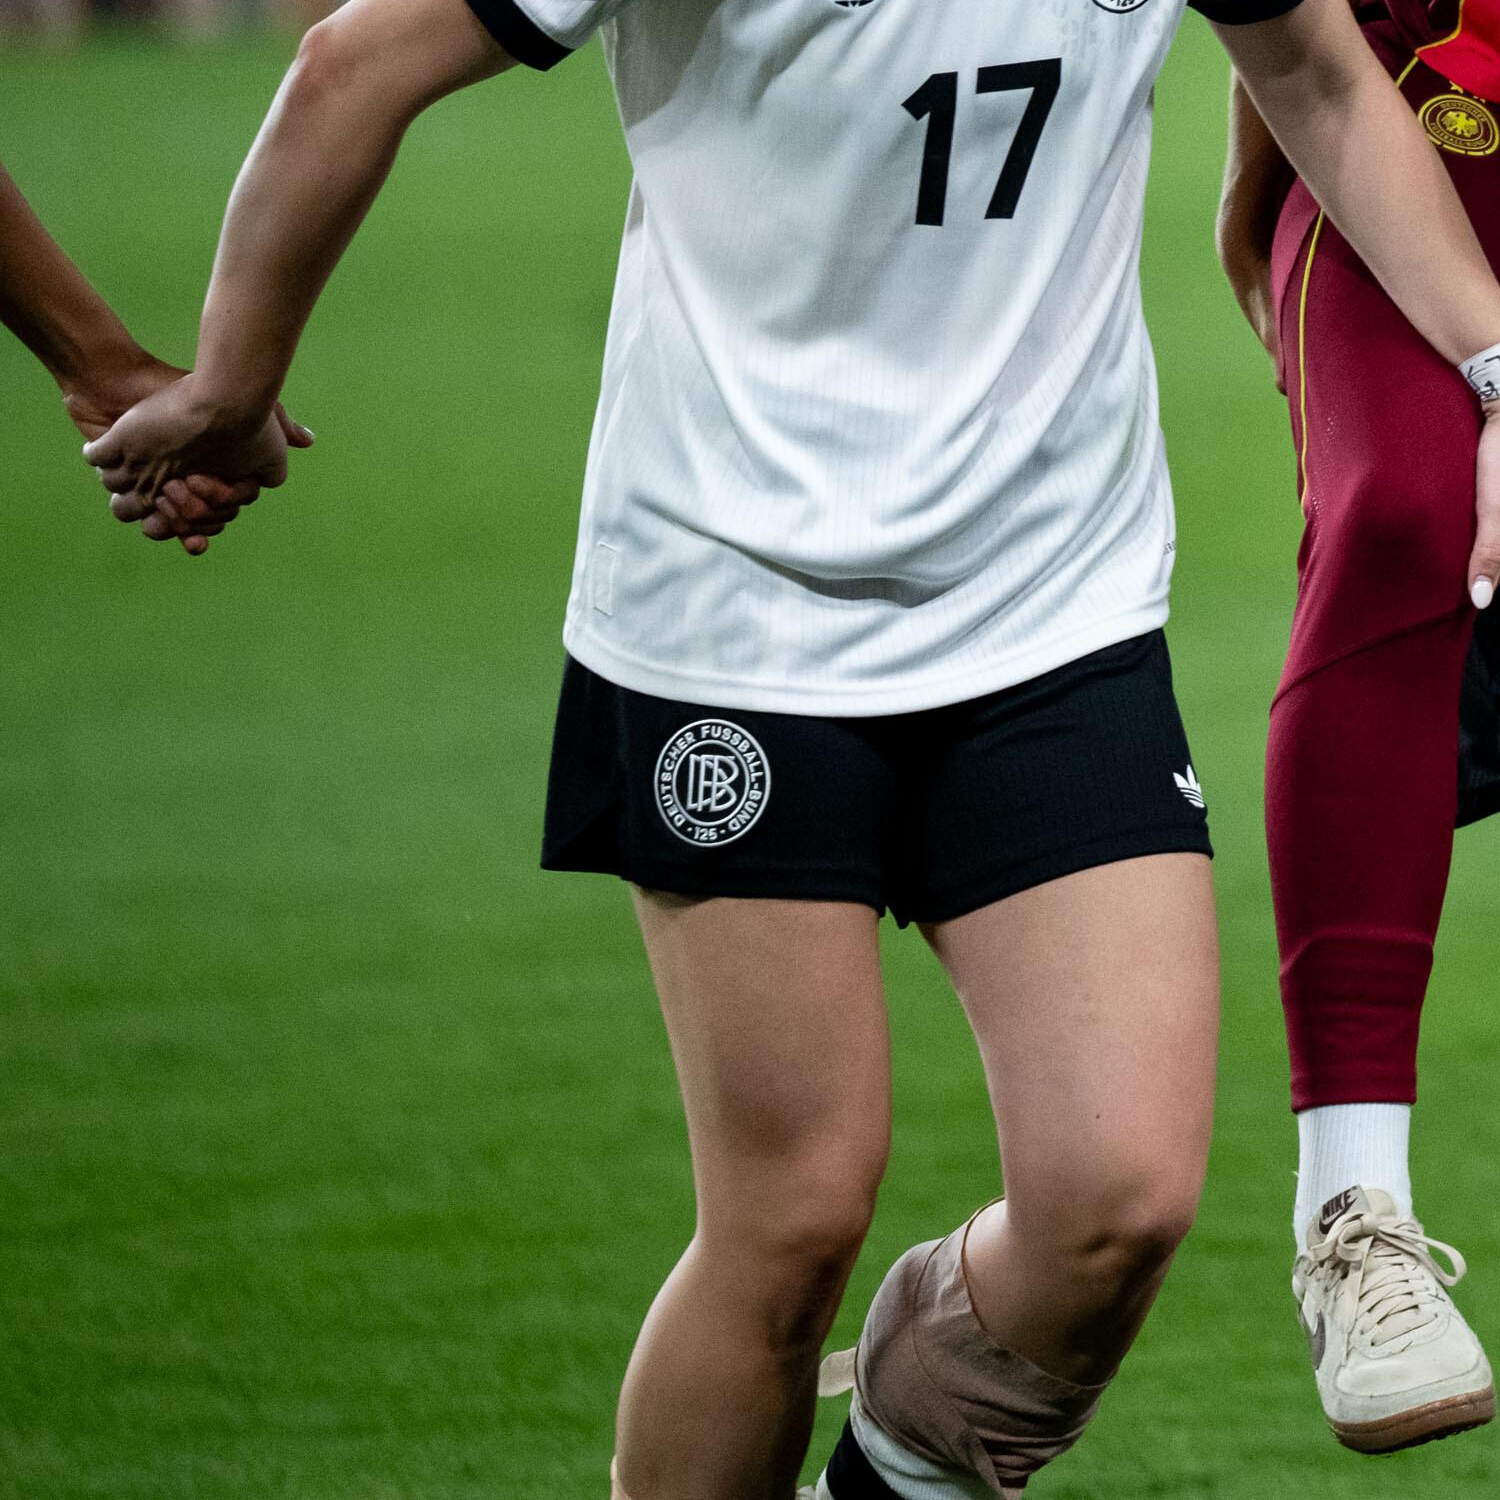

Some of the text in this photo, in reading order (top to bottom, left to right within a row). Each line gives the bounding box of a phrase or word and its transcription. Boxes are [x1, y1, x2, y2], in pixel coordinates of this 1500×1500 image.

[901, 58, 1061, 226] 17
[660, 725, 763, 831] DEUTSCHER FUSSBALL-BUND
[693, 826, 718, 840] 125
[1322, 1188, 1352, 1221] NIKE
